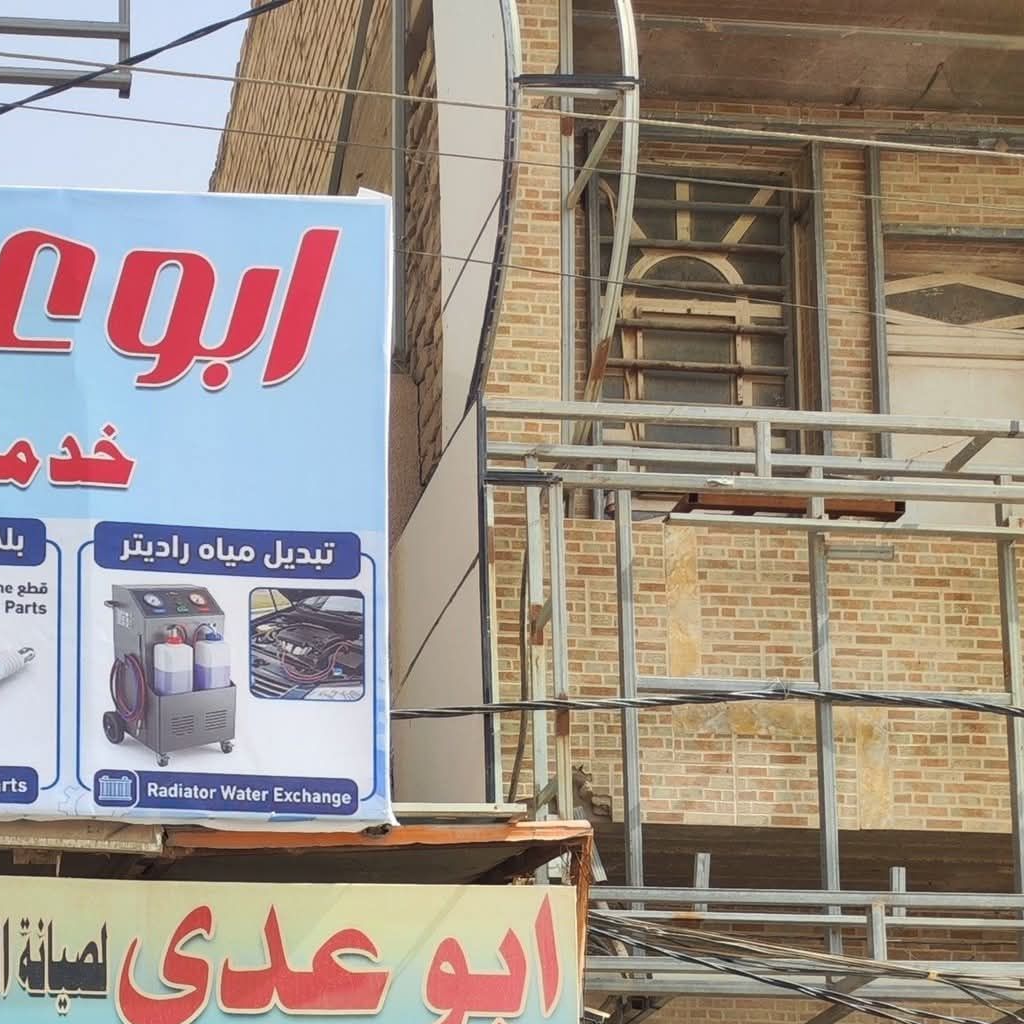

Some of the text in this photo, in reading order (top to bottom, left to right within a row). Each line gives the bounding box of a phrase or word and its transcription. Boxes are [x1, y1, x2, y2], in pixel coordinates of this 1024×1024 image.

[104, 227, 343, 390] ابو
[120, 533, 336, 570] تبديل مياه راديتر
[17, 582, 48, 597] قطع
[4, 599, 48, 615] Parts
[146, 782, 352, 808] Radiator Water Exchange
[18, 916, 109, 1015] لصيانة
